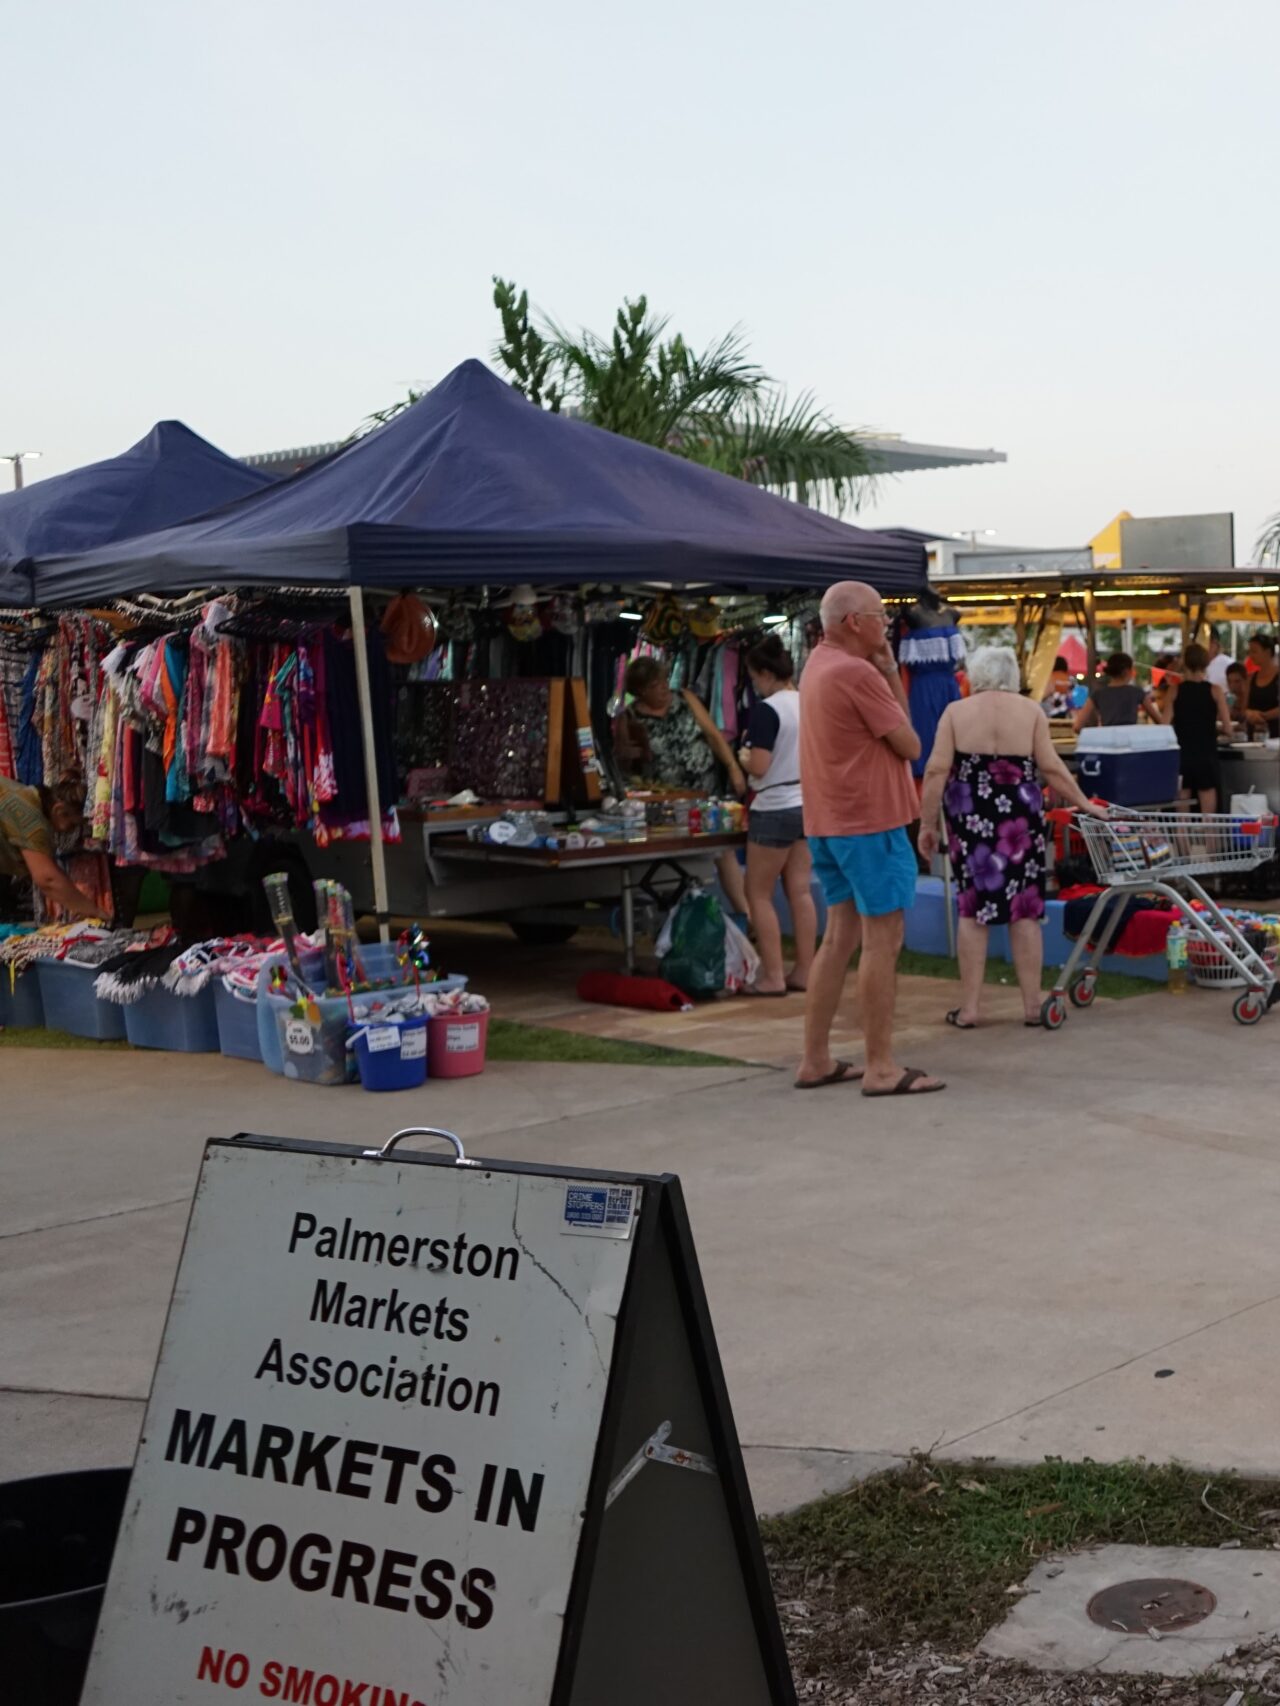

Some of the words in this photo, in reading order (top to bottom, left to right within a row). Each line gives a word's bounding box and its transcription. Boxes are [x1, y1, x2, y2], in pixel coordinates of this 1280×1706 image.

[567, 1201, 605, 1211] STOPPERS
[288, 1211, 520, 1281] Palmerston
[309, 1278, 470, 1343] Markets
[254, 1337, 501, 1417] Association
[164, 1408, 458, 1514] MARKETS
[473, 1463, 545, 1533] IN
[166, 1506, 497, 1630] PROGRESS
[196, 1646, 251, 1689] NO
[259, 1660, 430, 1706] SMOKI
